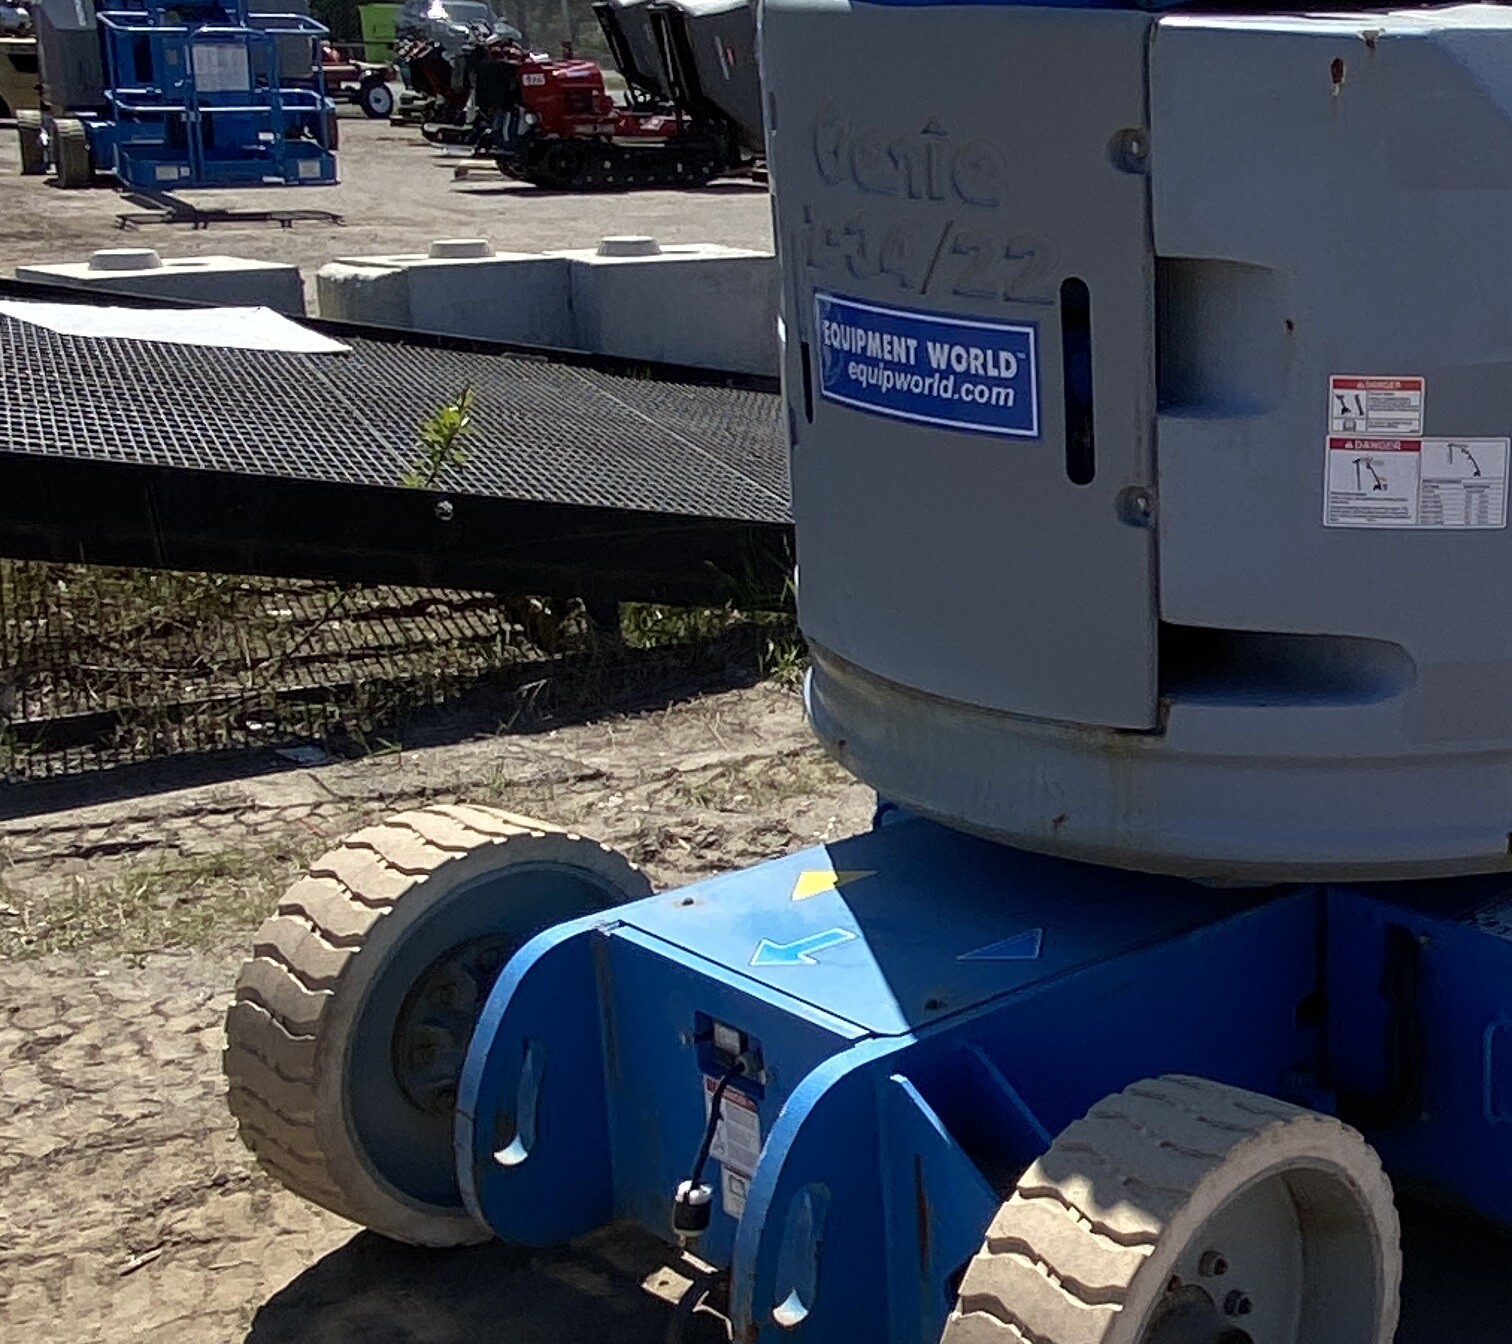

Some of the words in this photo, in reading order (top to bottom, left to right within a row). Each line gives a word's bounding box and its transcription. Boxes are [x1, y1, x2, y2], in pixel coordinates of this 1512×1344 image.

[821, 319, 918, 366] EQUIPMENT
[926, 340, 1018, 379] WORLD
[848, 360, 1015, 407] equipworld.com
